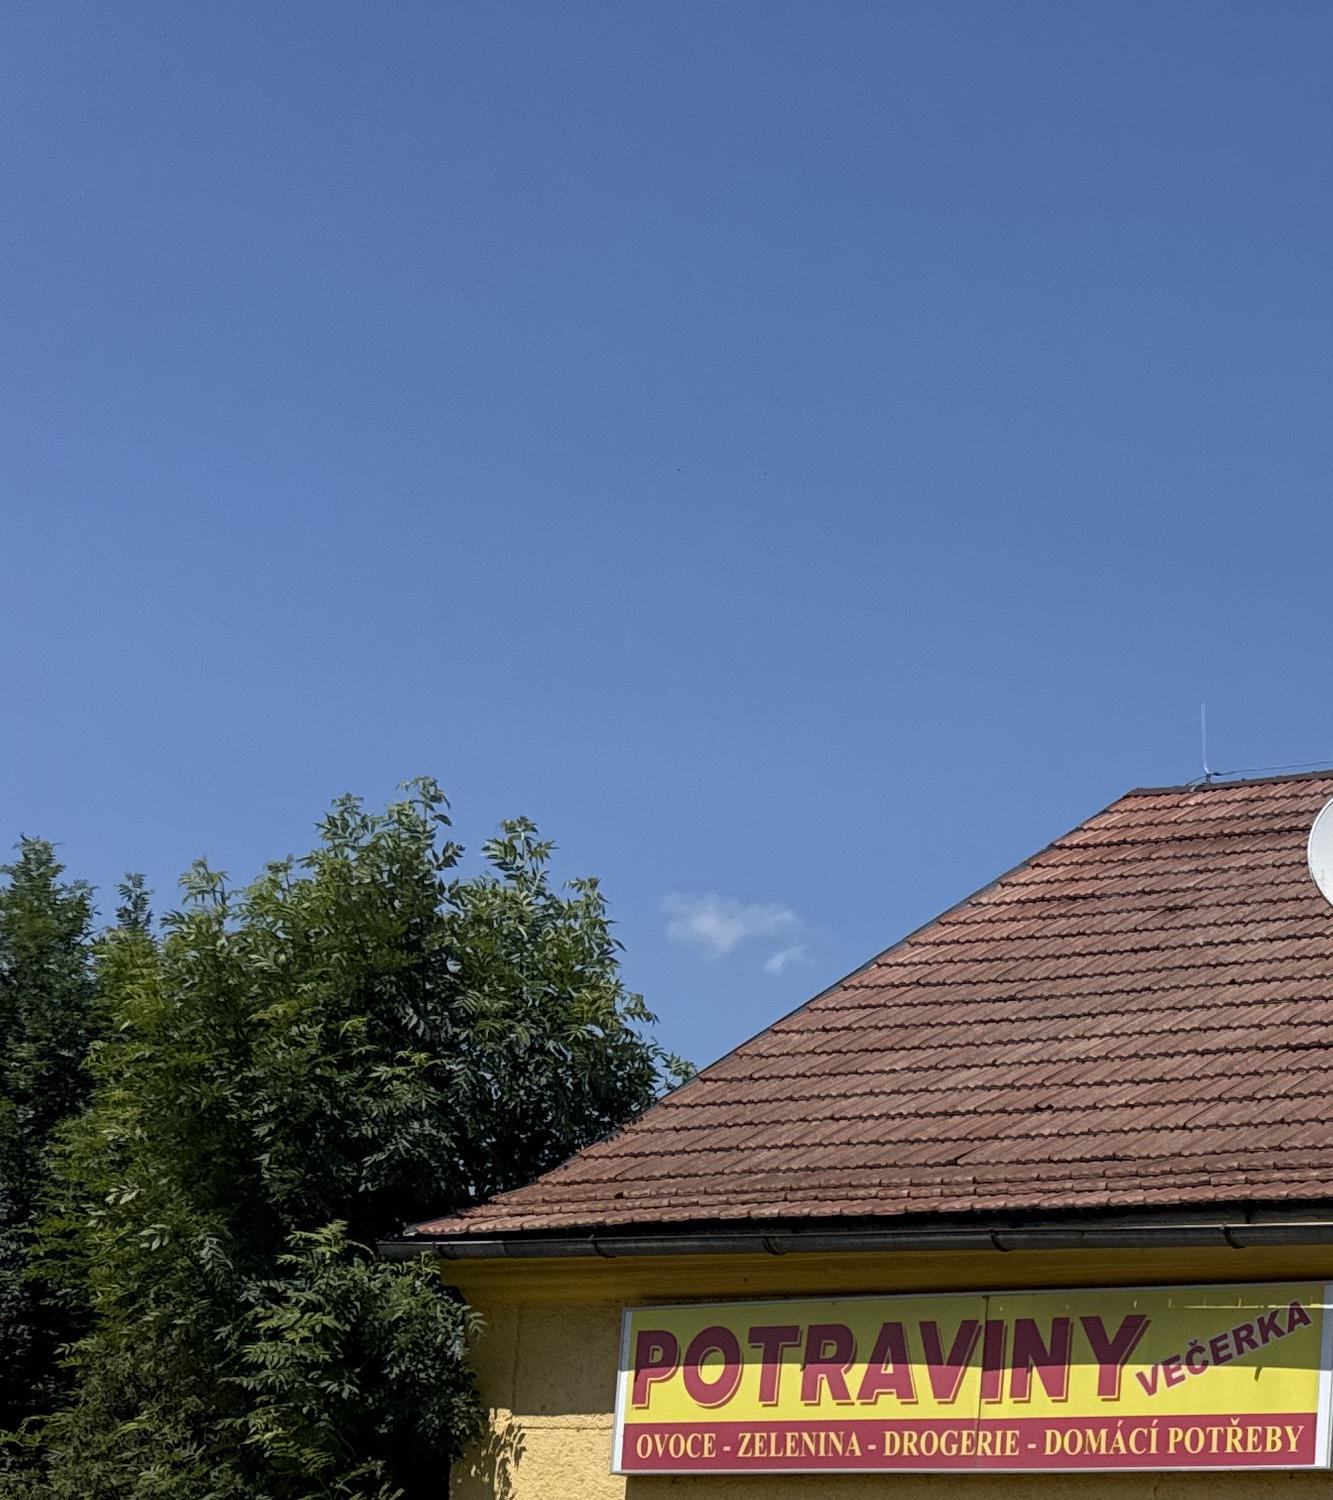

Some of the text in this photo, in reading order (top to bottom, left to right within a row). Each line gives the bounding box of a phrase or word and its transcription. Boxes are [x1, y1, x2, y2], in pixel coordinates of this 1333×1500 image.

[632, 1300, 1313, 1410] POTRAVINY VEČERKA
[636, 1432, 716, 1459] OVOCE
[737, 1431, 862, 1457] ZELENINA
[883, 1429, 1020, 1457] DROGERIE
[1043, 1419, 1160, 1456] DOMÁCÍ
[1168, 1418, 1305, 1454] POTŘEBY
